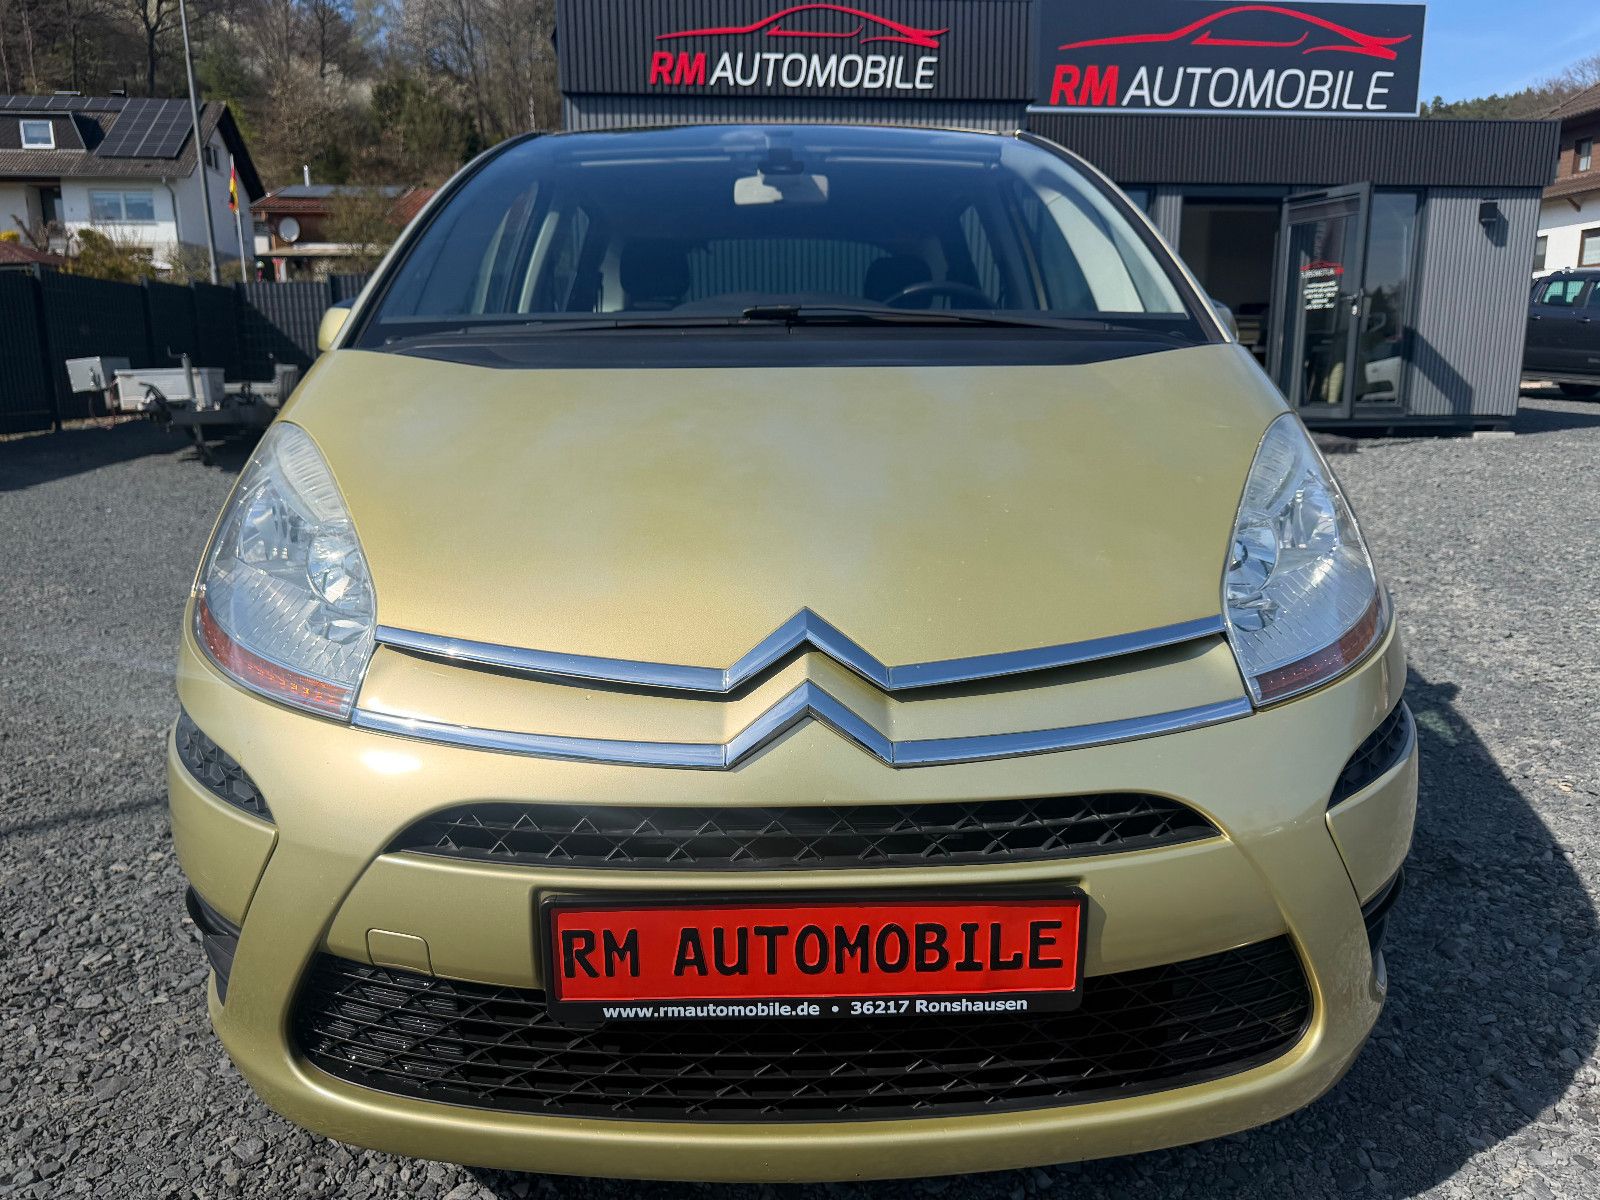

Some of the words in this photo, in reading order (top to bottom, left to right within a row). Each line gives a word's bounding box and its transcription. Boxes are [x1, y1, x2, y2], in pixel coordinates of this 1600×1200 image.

[649, 52, 706, 86] RM
[709, 54, 937, 90] AUTOMOBILE
[1049, 64, 1119, 106] RM
[1121, 67, 1394, 111] AUTOMOBILE
[562, 929, 639, 978] RM
[674, 921, 1063, 976] AUTOMOBILE
[603, 1003, 820, 1019] www.rmautomobile.de
[850, 1001, 910, 1016] 36217
[916, 998, 1027, 1014] Ronshausen
